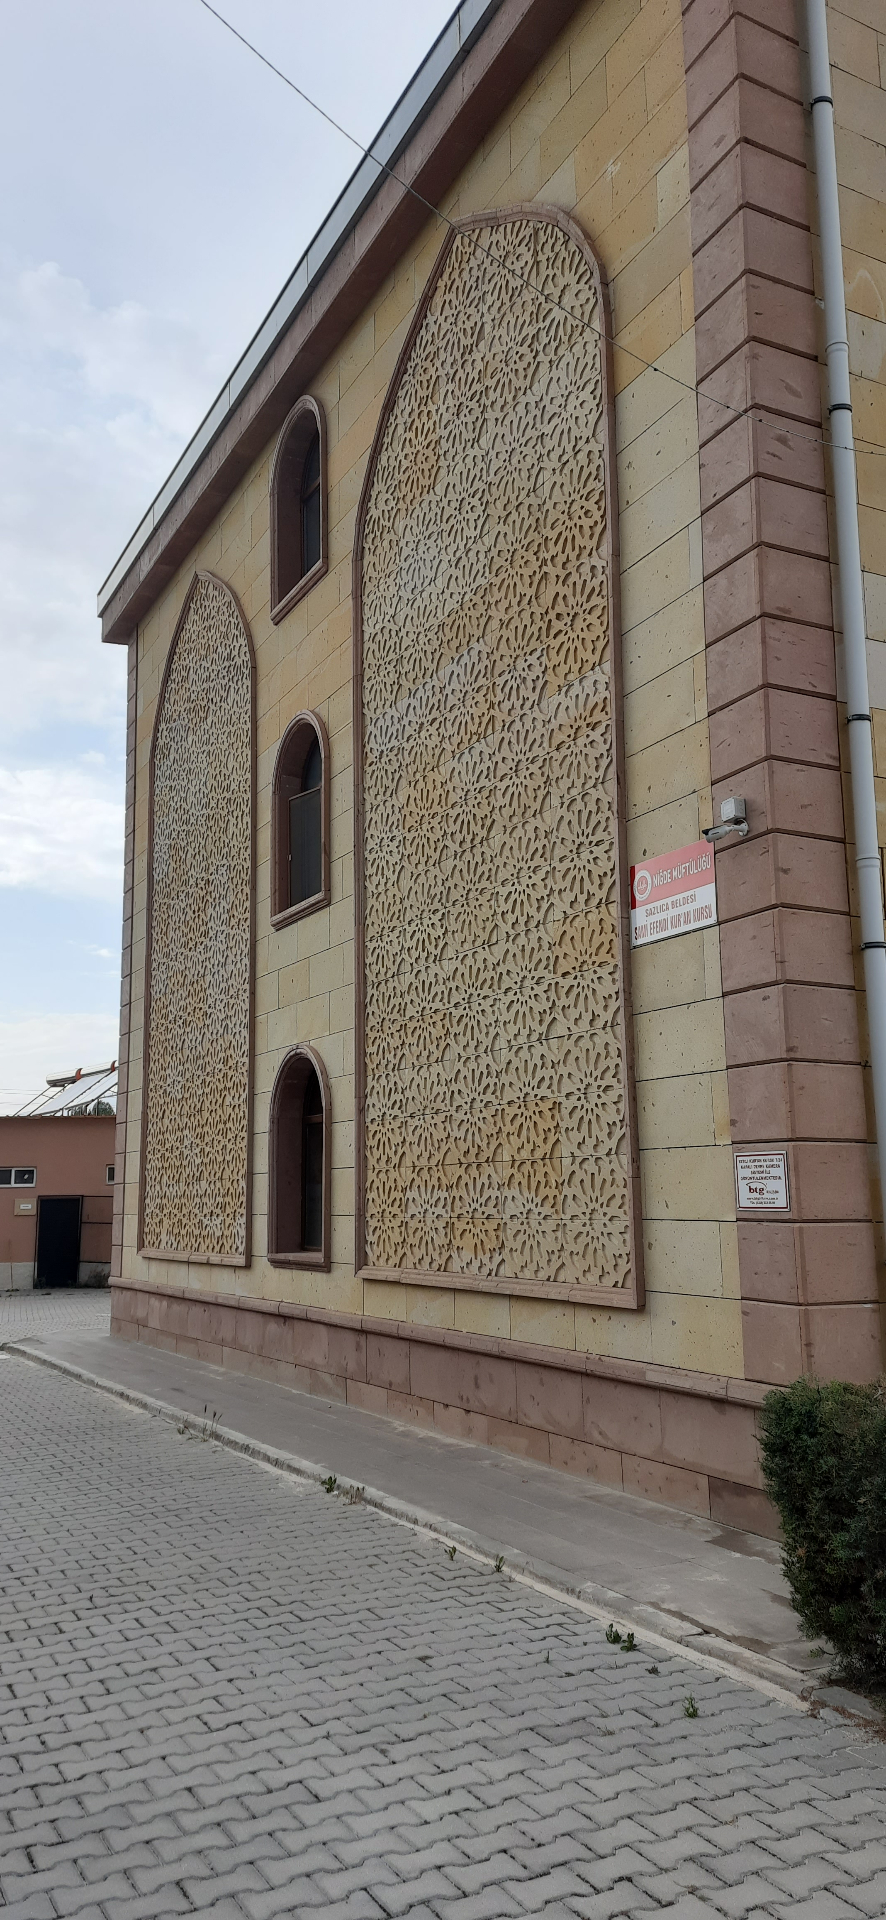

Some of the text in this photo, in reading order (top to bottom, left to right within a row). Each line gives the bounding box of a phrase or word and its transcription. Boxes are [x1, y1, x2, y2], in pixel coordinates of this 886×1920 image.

[653, 868, 672, 887] NİĞDE
[672, 852, 711, 879] MÜFTÜLÜĞÜ
[645, 891, 697, 918] SAZLICA BELDESİ
[649, 914, 669, 936] EFENDİ
[670, 909, 692, 930] KUR'AN
[692, 903, 713, 923] KURSU
[748, 1186, 765, 1196] btg
